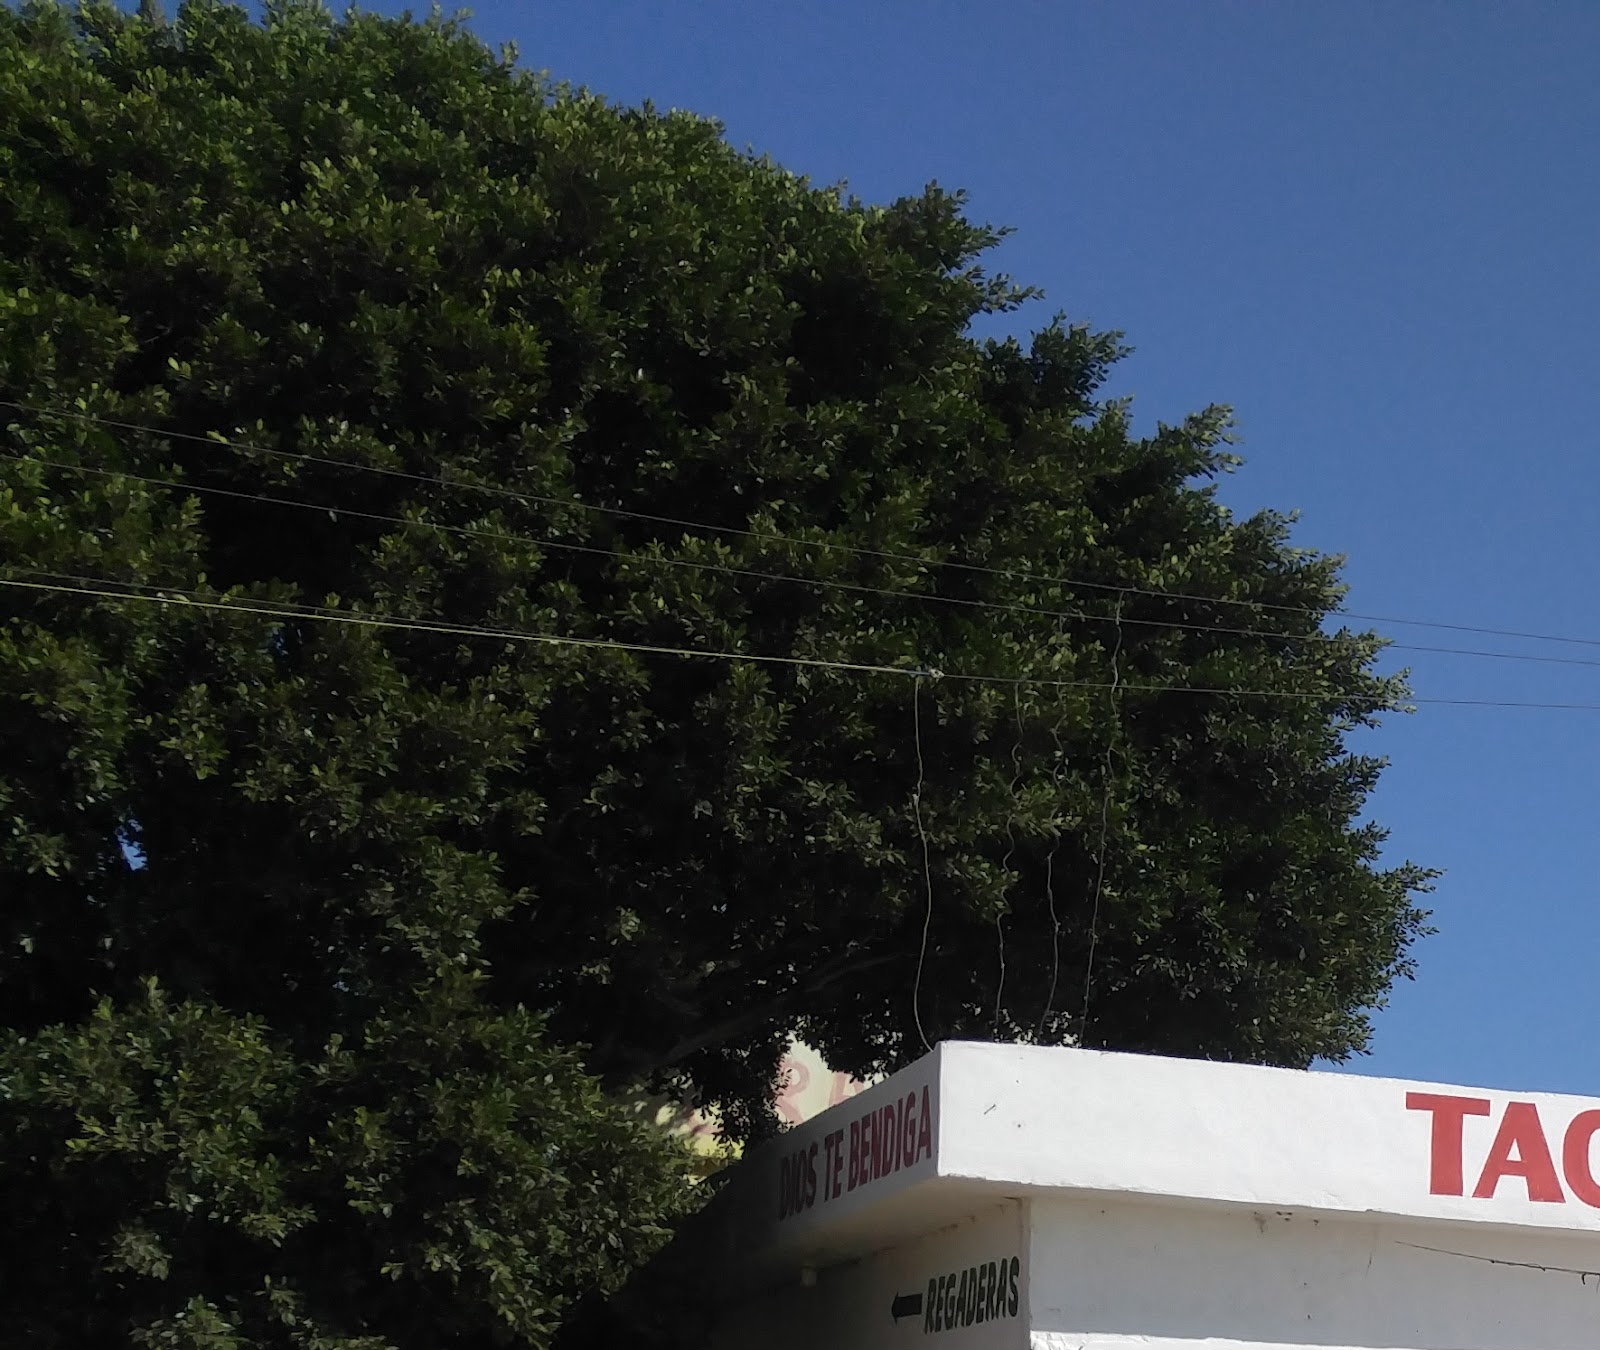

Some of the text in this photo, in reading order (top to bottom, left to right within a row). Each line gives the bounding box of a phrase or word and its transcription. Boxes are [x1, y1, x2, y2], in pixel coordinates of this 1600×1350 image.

[778, 1140, 818, 1221] DIOS
[823, 1128, 845, 1203] TE
[847, 1084, 932, 1193] BENDIGA
[924, 1255, 1020, 1335] REGADERAS
